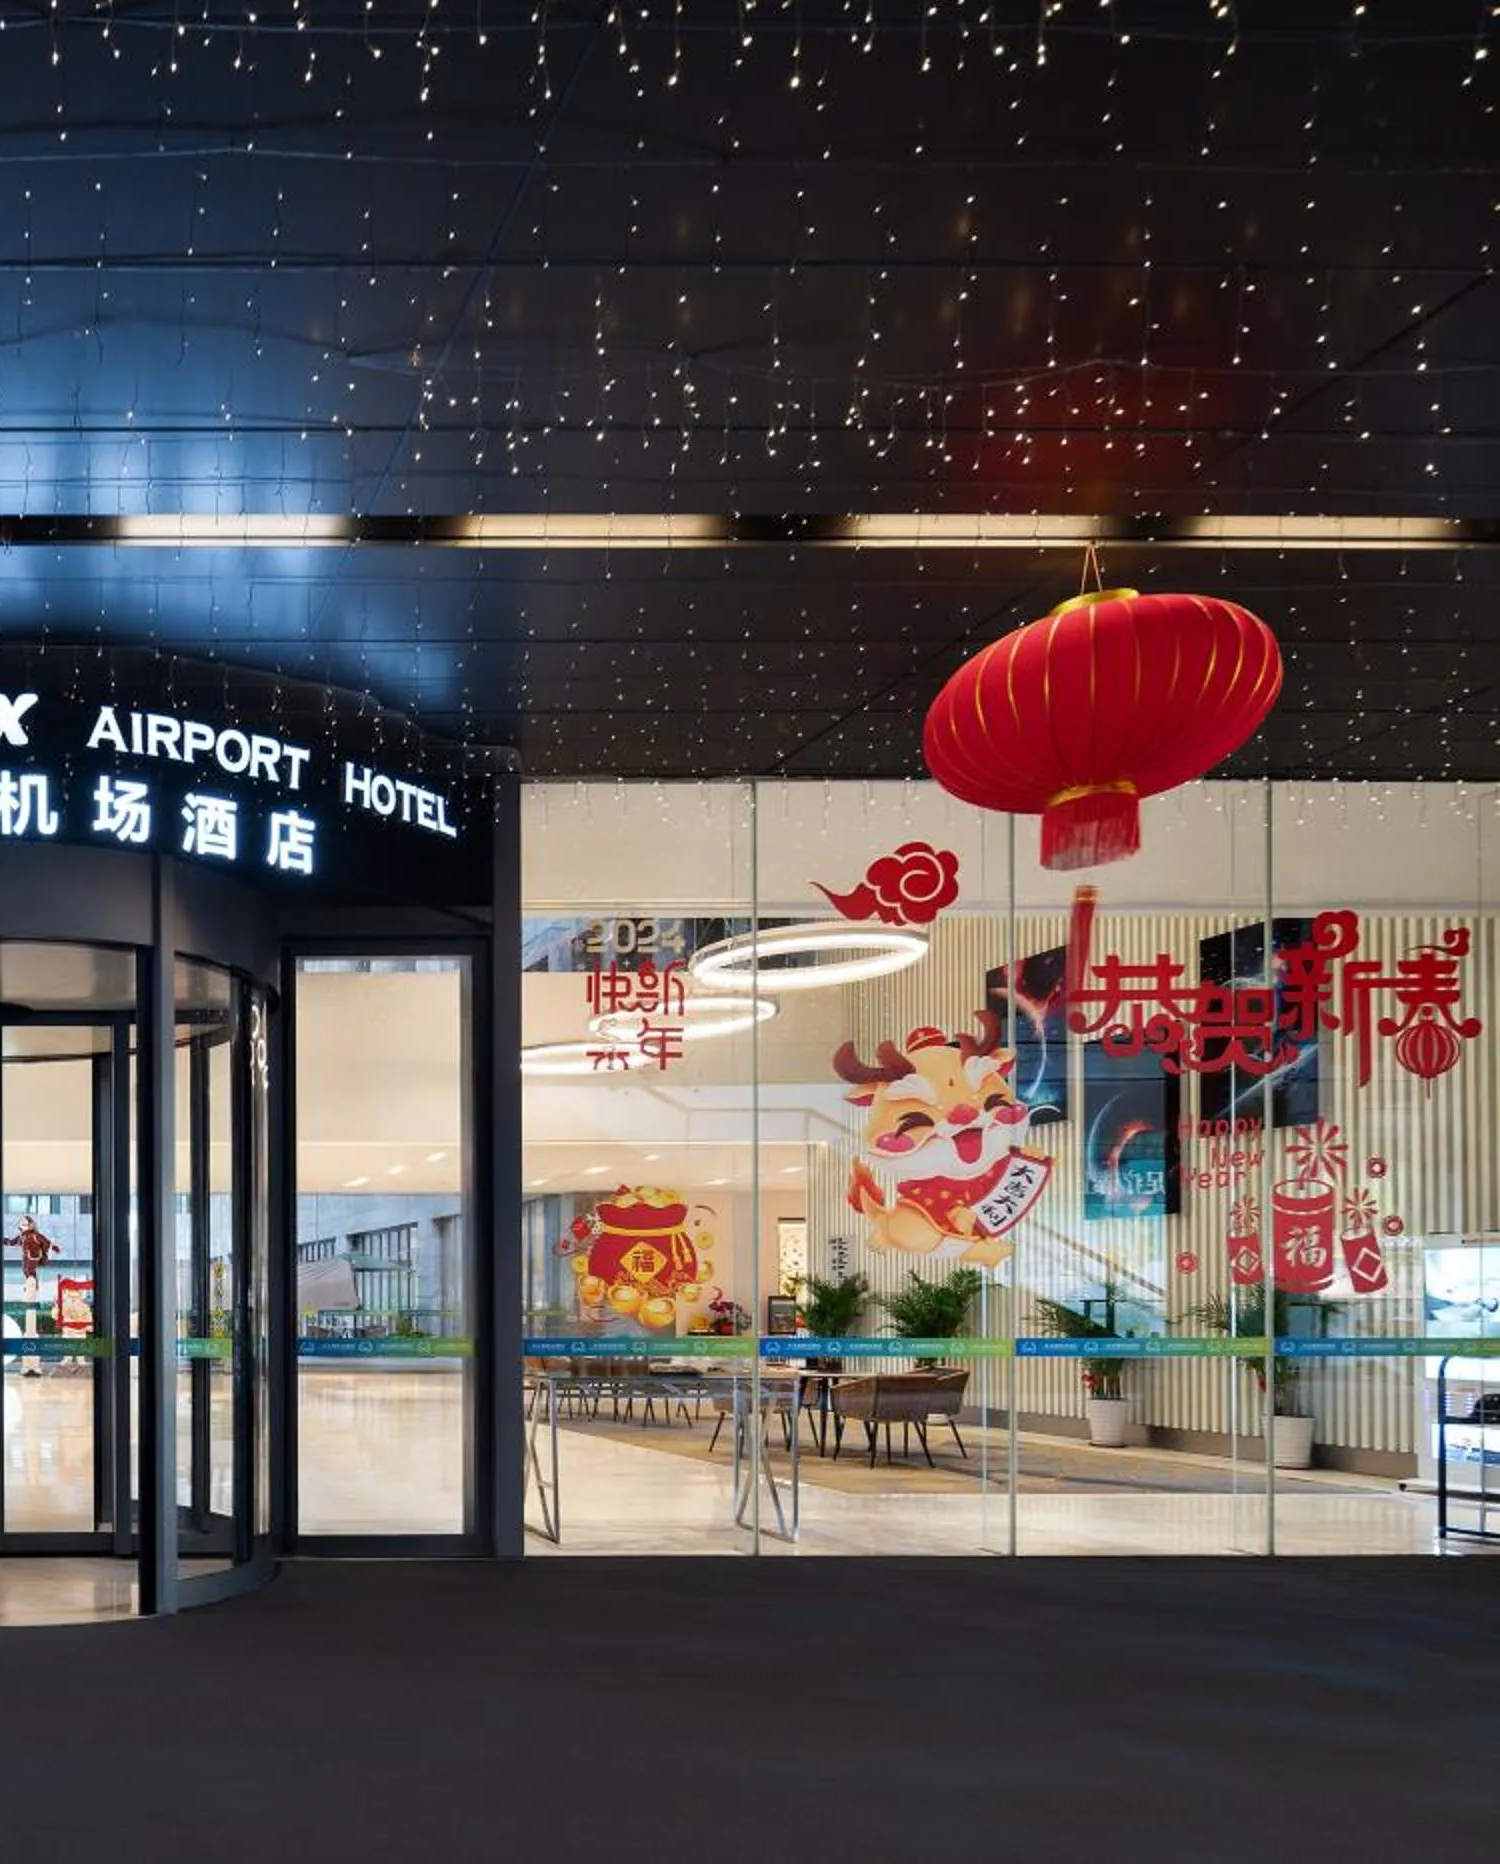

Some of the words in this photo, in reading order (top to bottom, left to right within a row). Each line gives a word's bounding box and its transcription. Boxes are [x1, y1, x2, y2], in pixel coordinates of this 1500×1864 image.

[87, 706, 310, 789] AIRPORT
[344, 760, 458, 838] HOTEL
[585, 918, 686, 953] 2024
[1178, 1116, 1262, 1139] Happy
[1211, 1147, 1264, 1169] New
[631, 1250, 656, 1274] 福
[1281, 1228, 1328, 1270] 福
